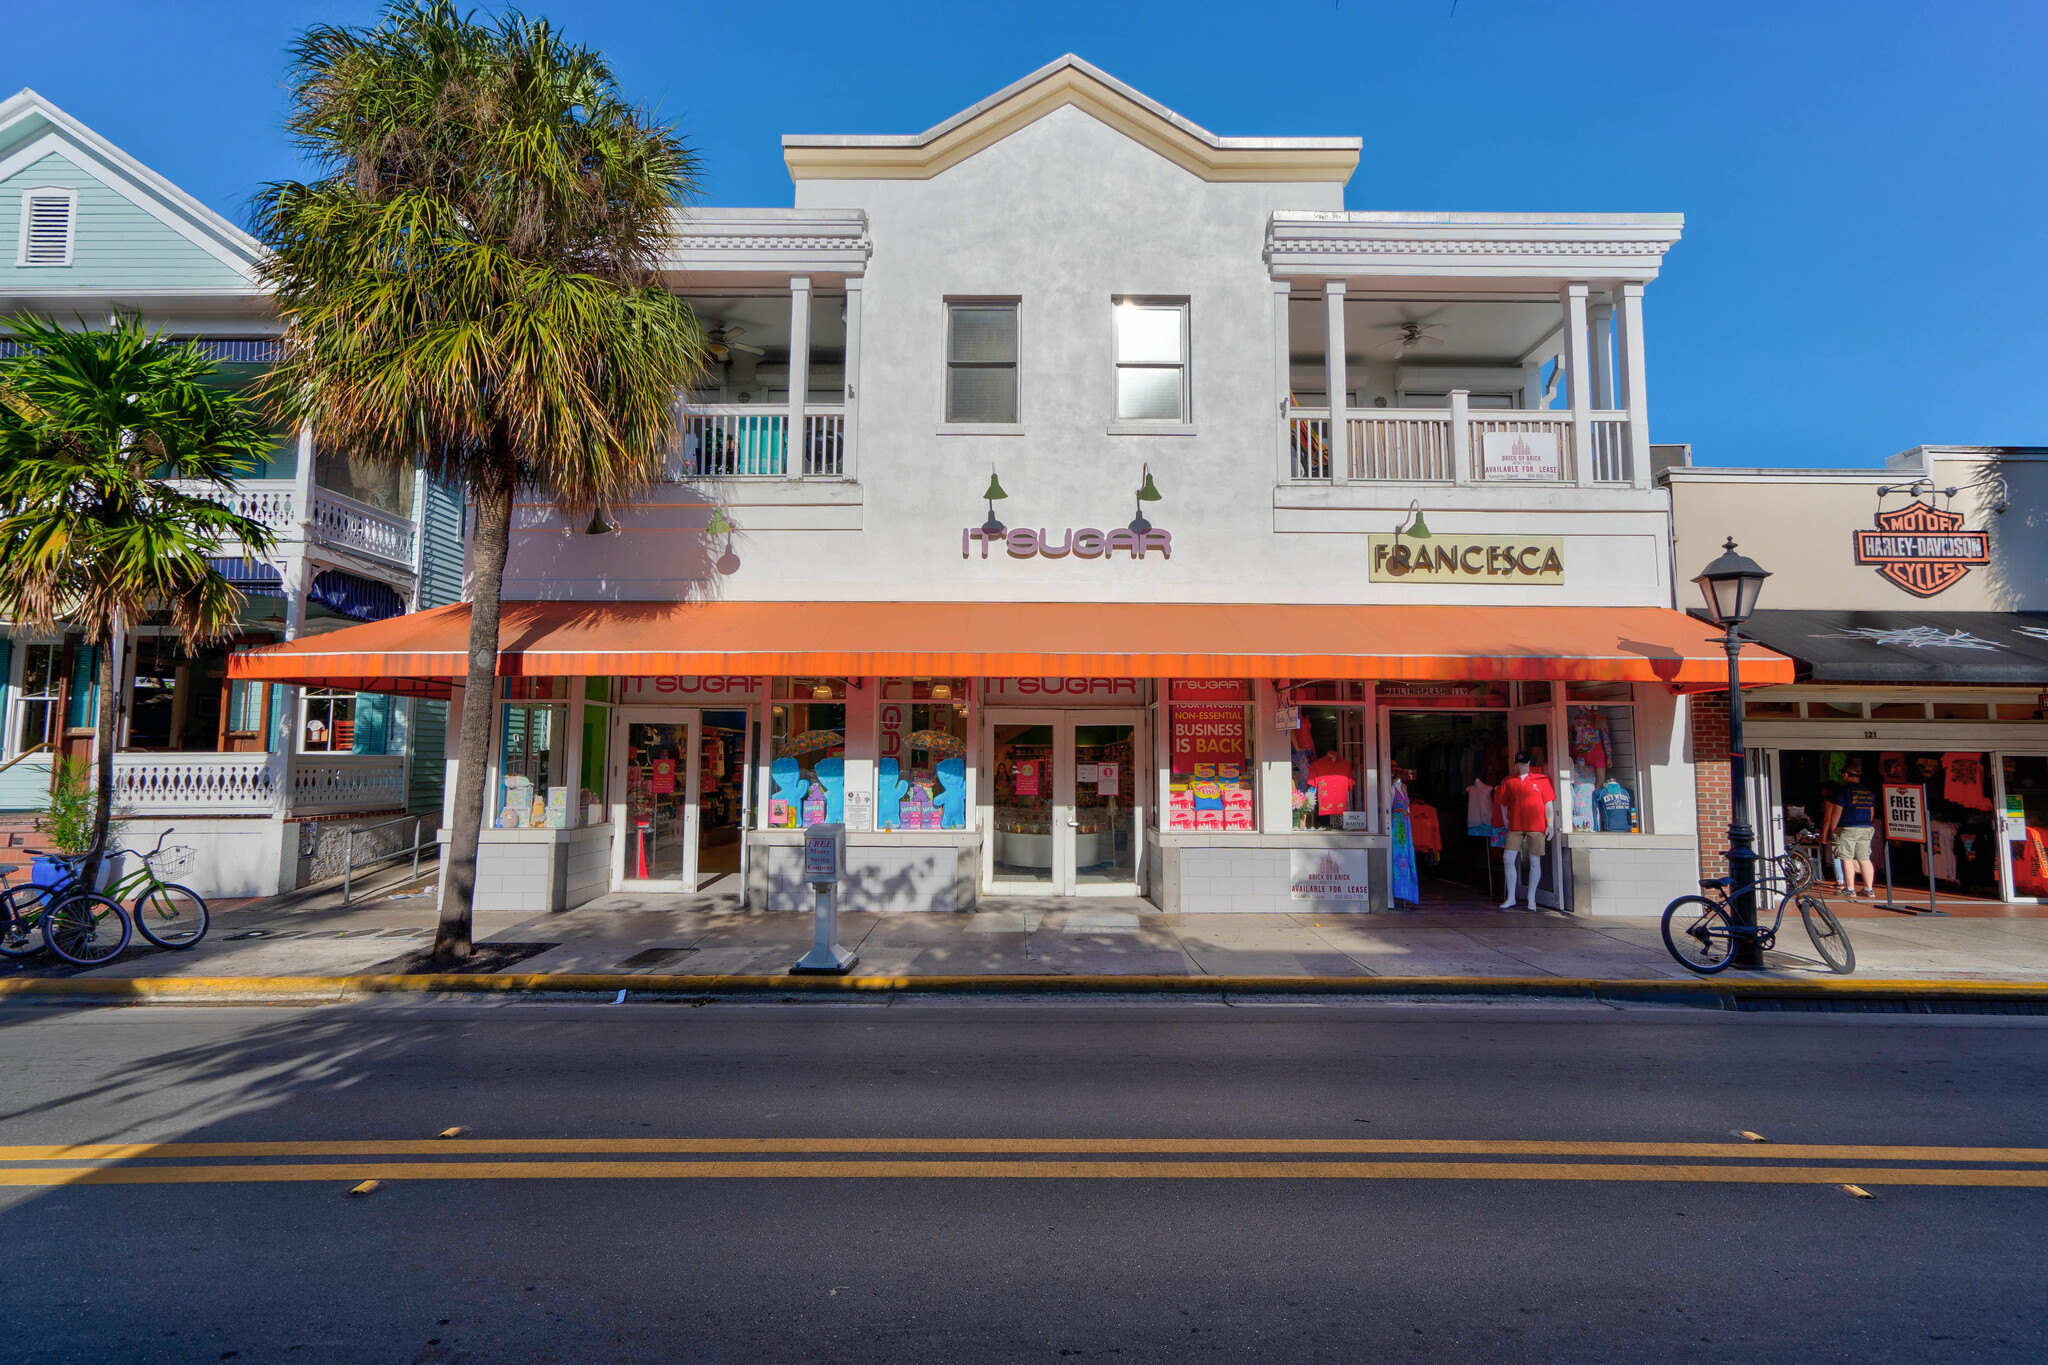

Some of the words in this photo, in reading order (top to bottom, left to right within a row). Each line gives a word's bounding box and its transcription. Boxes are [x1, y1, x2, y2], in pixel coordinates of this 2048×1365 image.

[1890, 511, 1952, 532] MOTOR
[1864, 537, 1983, 558] HARLEY-DAVIDSON
[1375, 543, 1564, 575] FRANCESCA
[1892, 563, 1956, 590] CYCLES
[1175, 711, 1242, 720] NON-ESSENTIAL
[1175, 723, 1243, 736] BUSINESS
[1176, 738, 1191, 753] IS
[1196, 738, 1243, 753] BACK
[1890, 796, 1916, 808] FREE
[1891, 809, 1916, 822] GIFT
[807, 840, 833, 848] FREE
[1329, 885, 1341, 893] FOR
